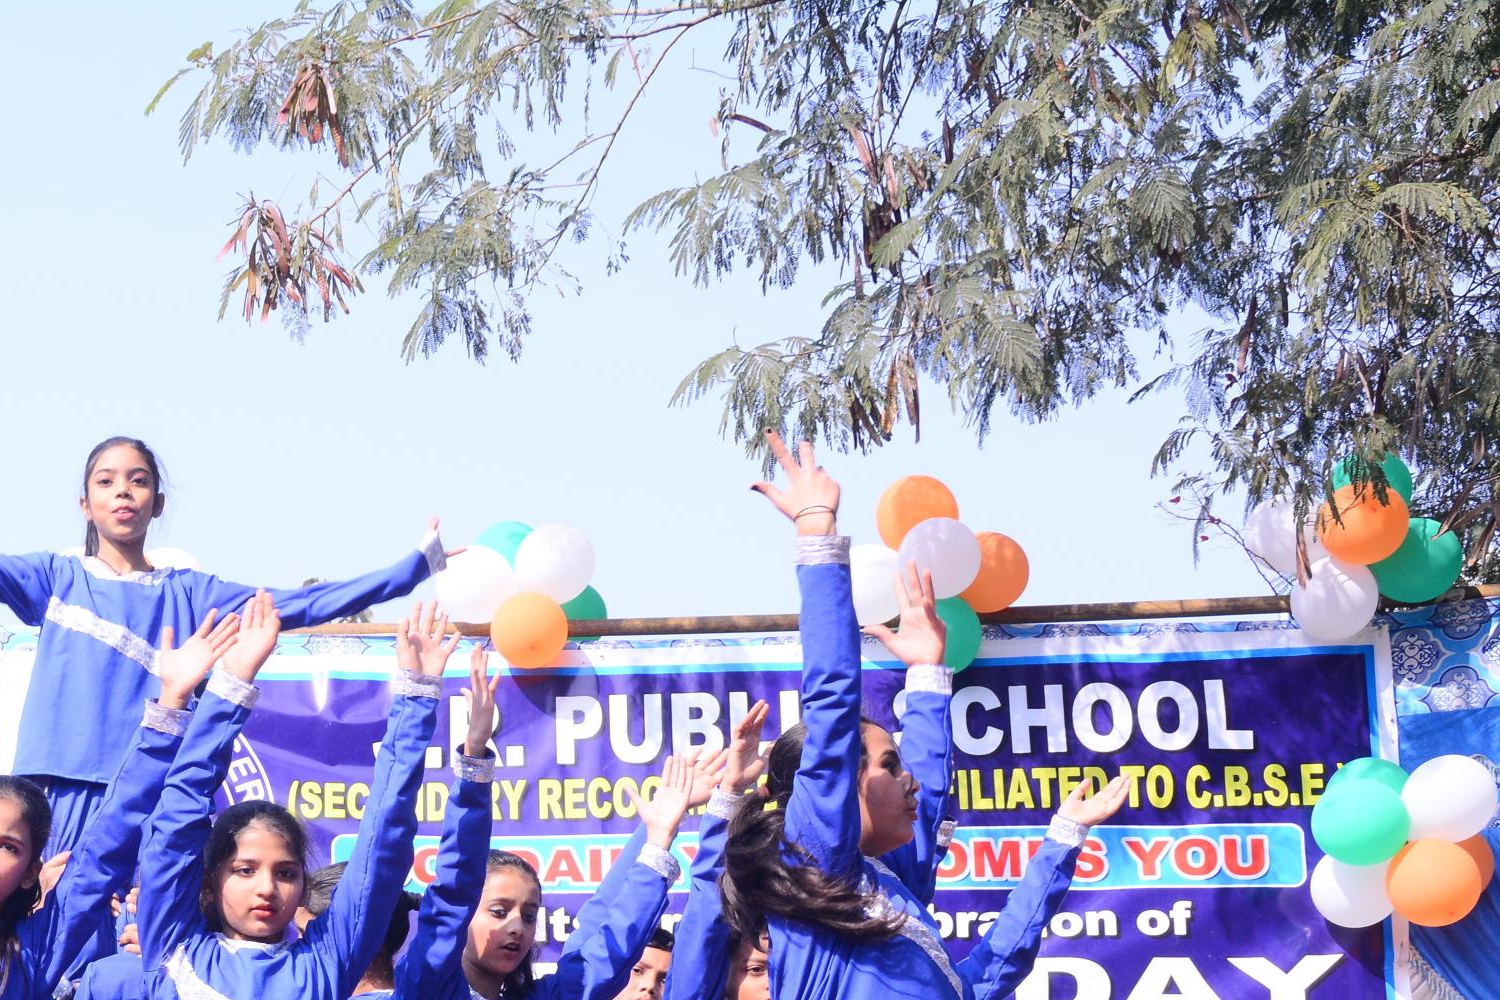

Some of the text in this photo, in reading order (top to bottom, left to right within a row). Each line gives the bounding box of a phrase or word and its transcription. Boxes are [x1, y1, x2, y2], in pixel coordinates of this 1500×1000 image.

[555, 690, 801, 766] PUBLI
[892, 680, 1255, 756] CHOOL
[288, 778, 528, 821] (SECDRY
[950, 766, 1109, 811] ILIATED
[1119, 764, 1175, 809] TO
[1185, 762, 1343, 809] C.B.S.E
[1124, 837, 1267, 878] YOU
[1136, 900, 1193, 937] of
